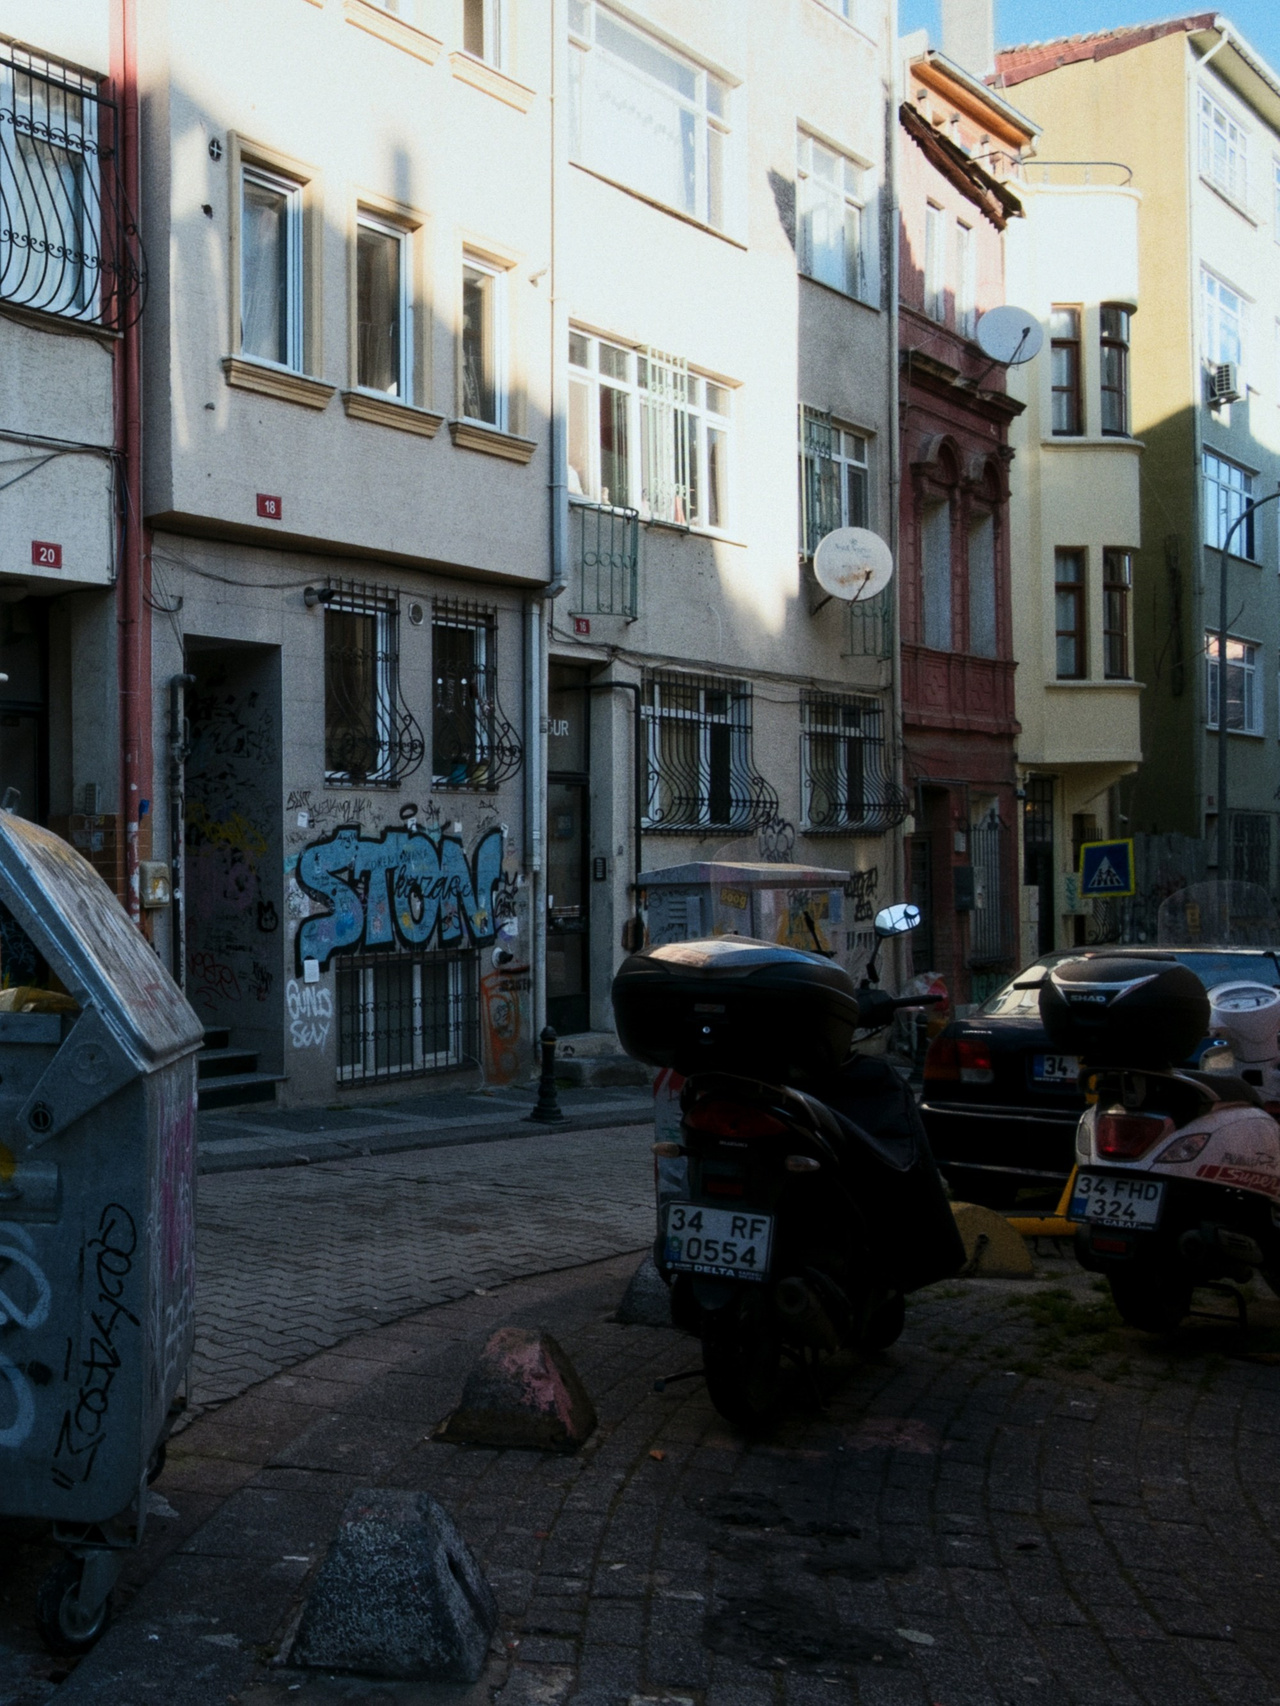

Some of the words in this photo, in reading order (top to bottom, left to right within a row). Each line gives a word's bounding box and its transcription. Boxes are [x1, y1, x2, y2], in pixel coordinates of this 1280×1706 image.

[264, 499, 277, 515] 18
[39, 546, 56, 564] 20
[1070, 994, 1106, 1003] SHAD
[1044, 1056, 1068, 1076] 34
[1079, 1177, 1107, 1196] 34
[1113, 1180, 1158, 1201] FHD
[1092, 1199, 1136, 1219] 324
[671, 1208, 704, 1233] 34
[731, 1215, 767, 1239] RF
[686, 1237, 757, 1268] 0554
[693, 1263, 736, 1278] DELTA
